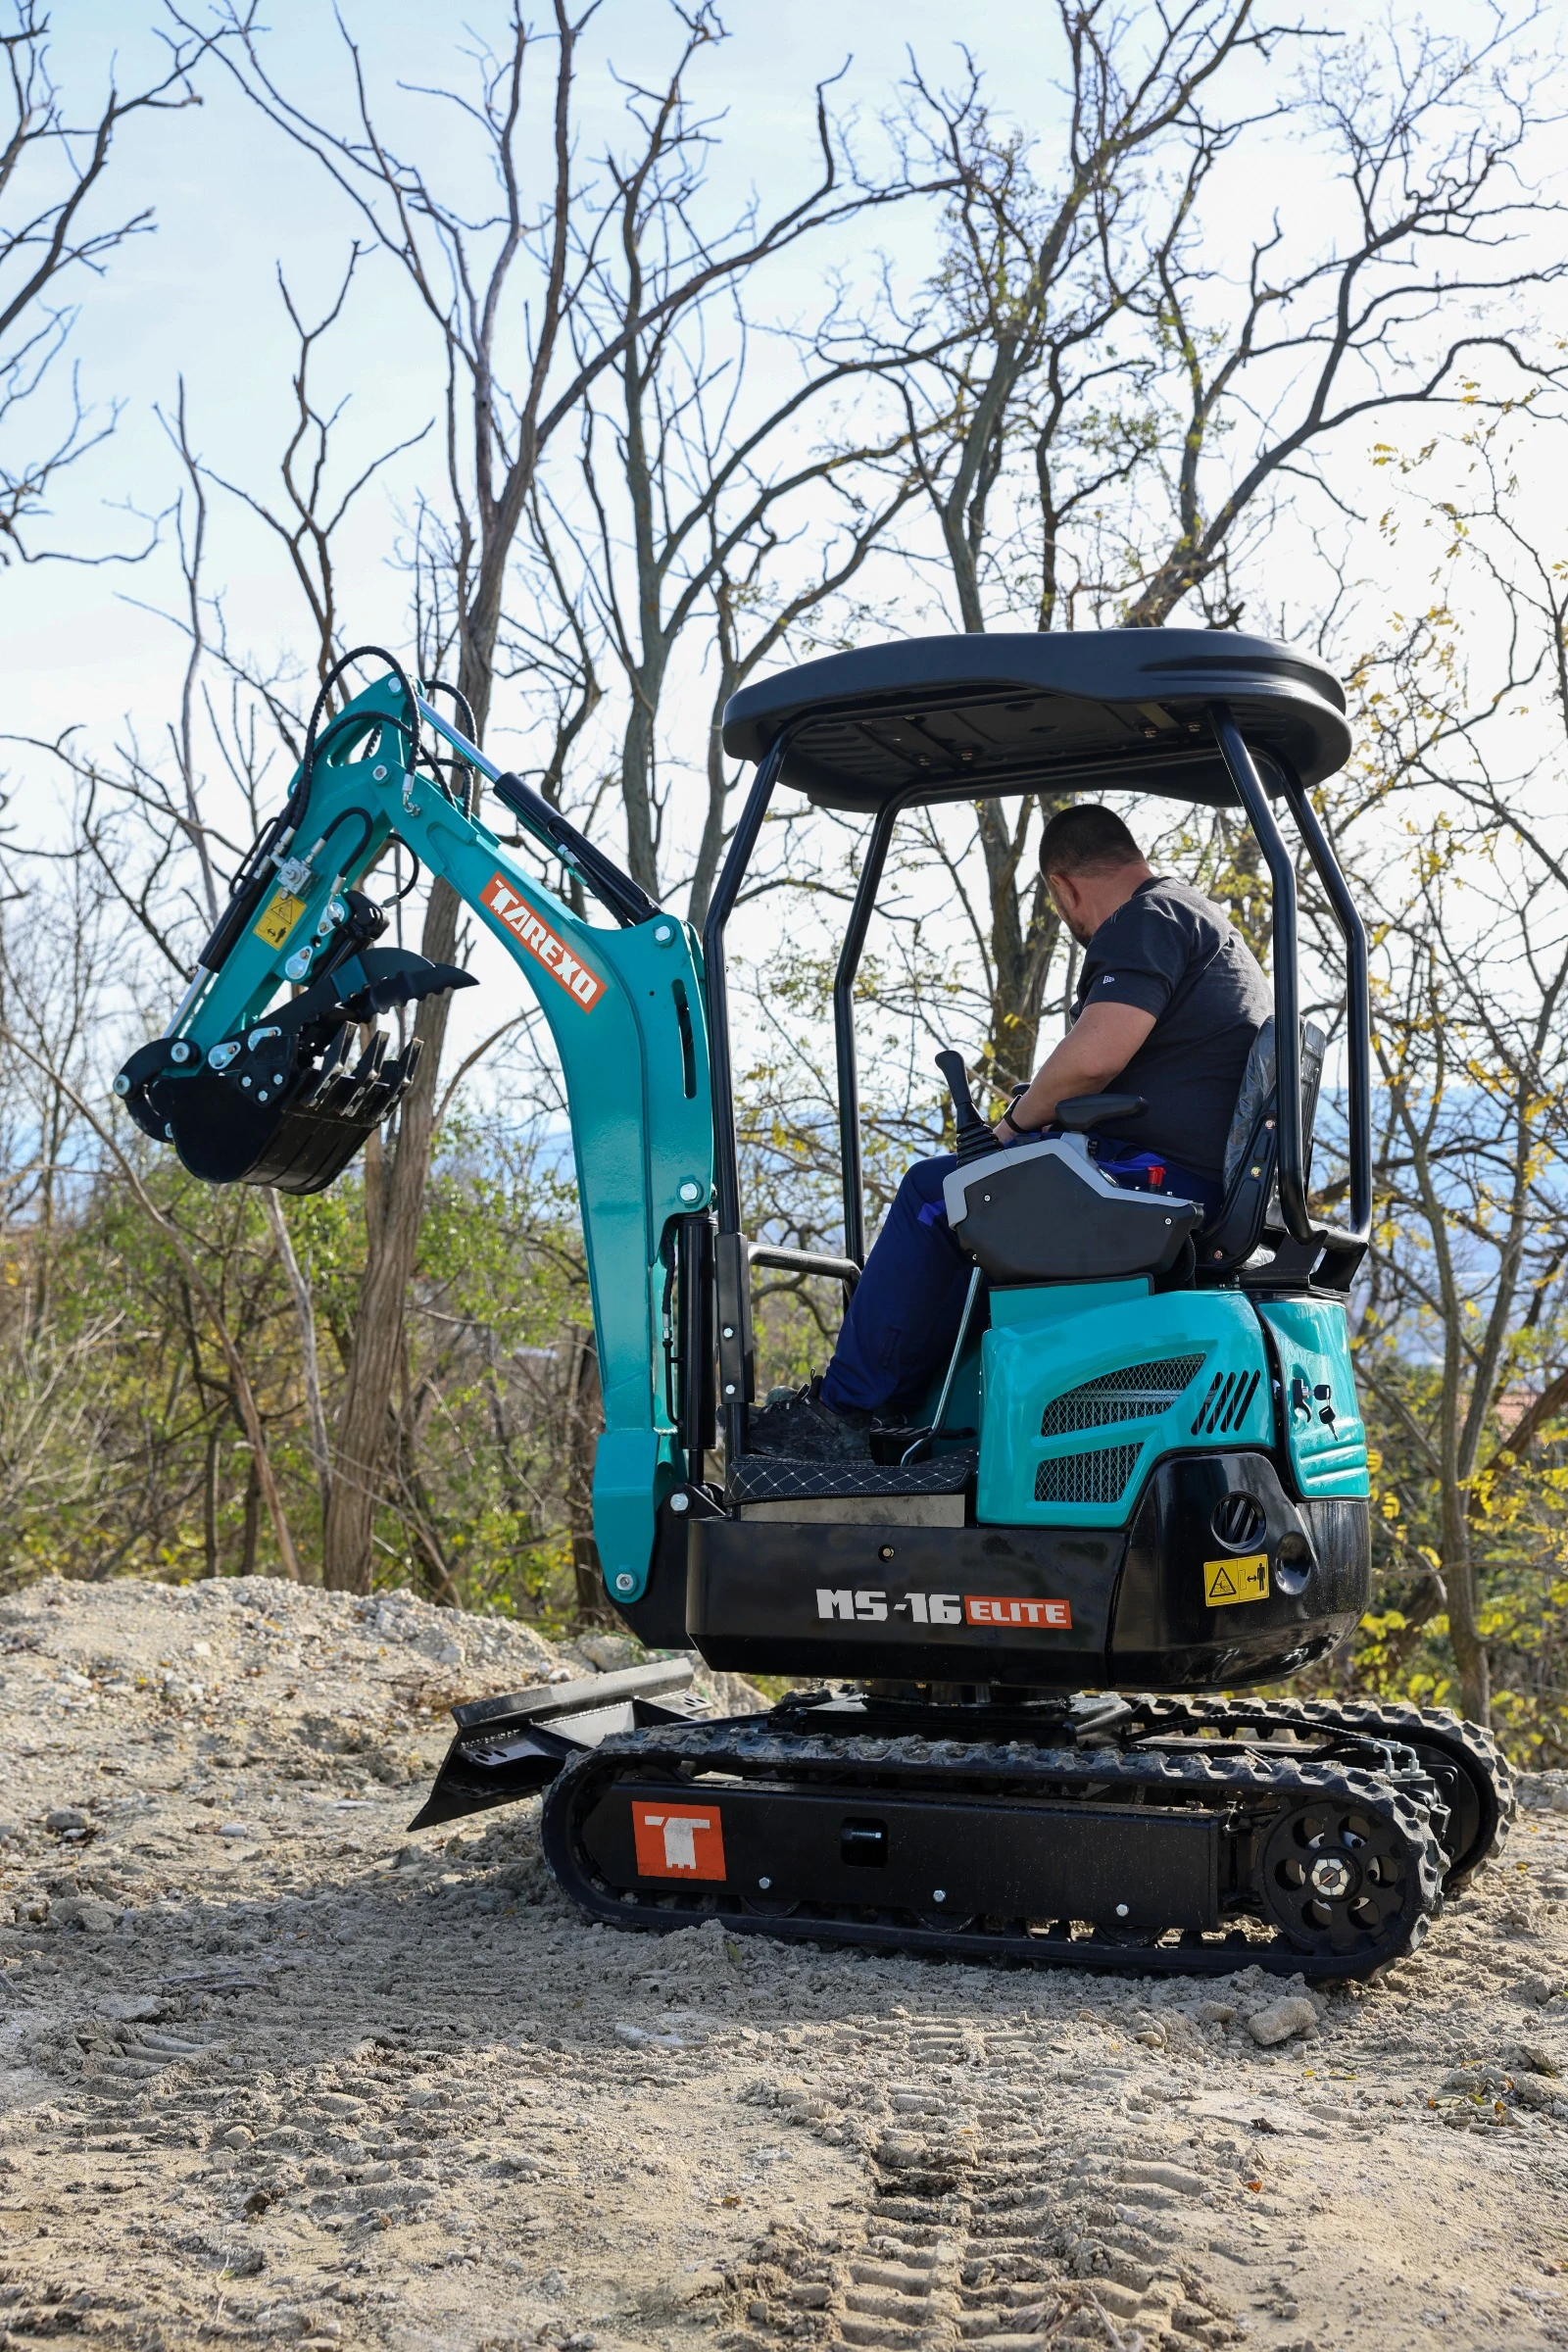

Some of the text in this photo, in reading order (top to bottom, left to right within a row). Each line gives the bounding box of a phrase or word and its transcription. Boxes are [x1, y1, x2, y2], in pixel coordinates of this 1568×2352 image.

[490, 879, 598, 1004] TAREXO
[816, 1589, 1066, 1625] MS-16 ELITE
